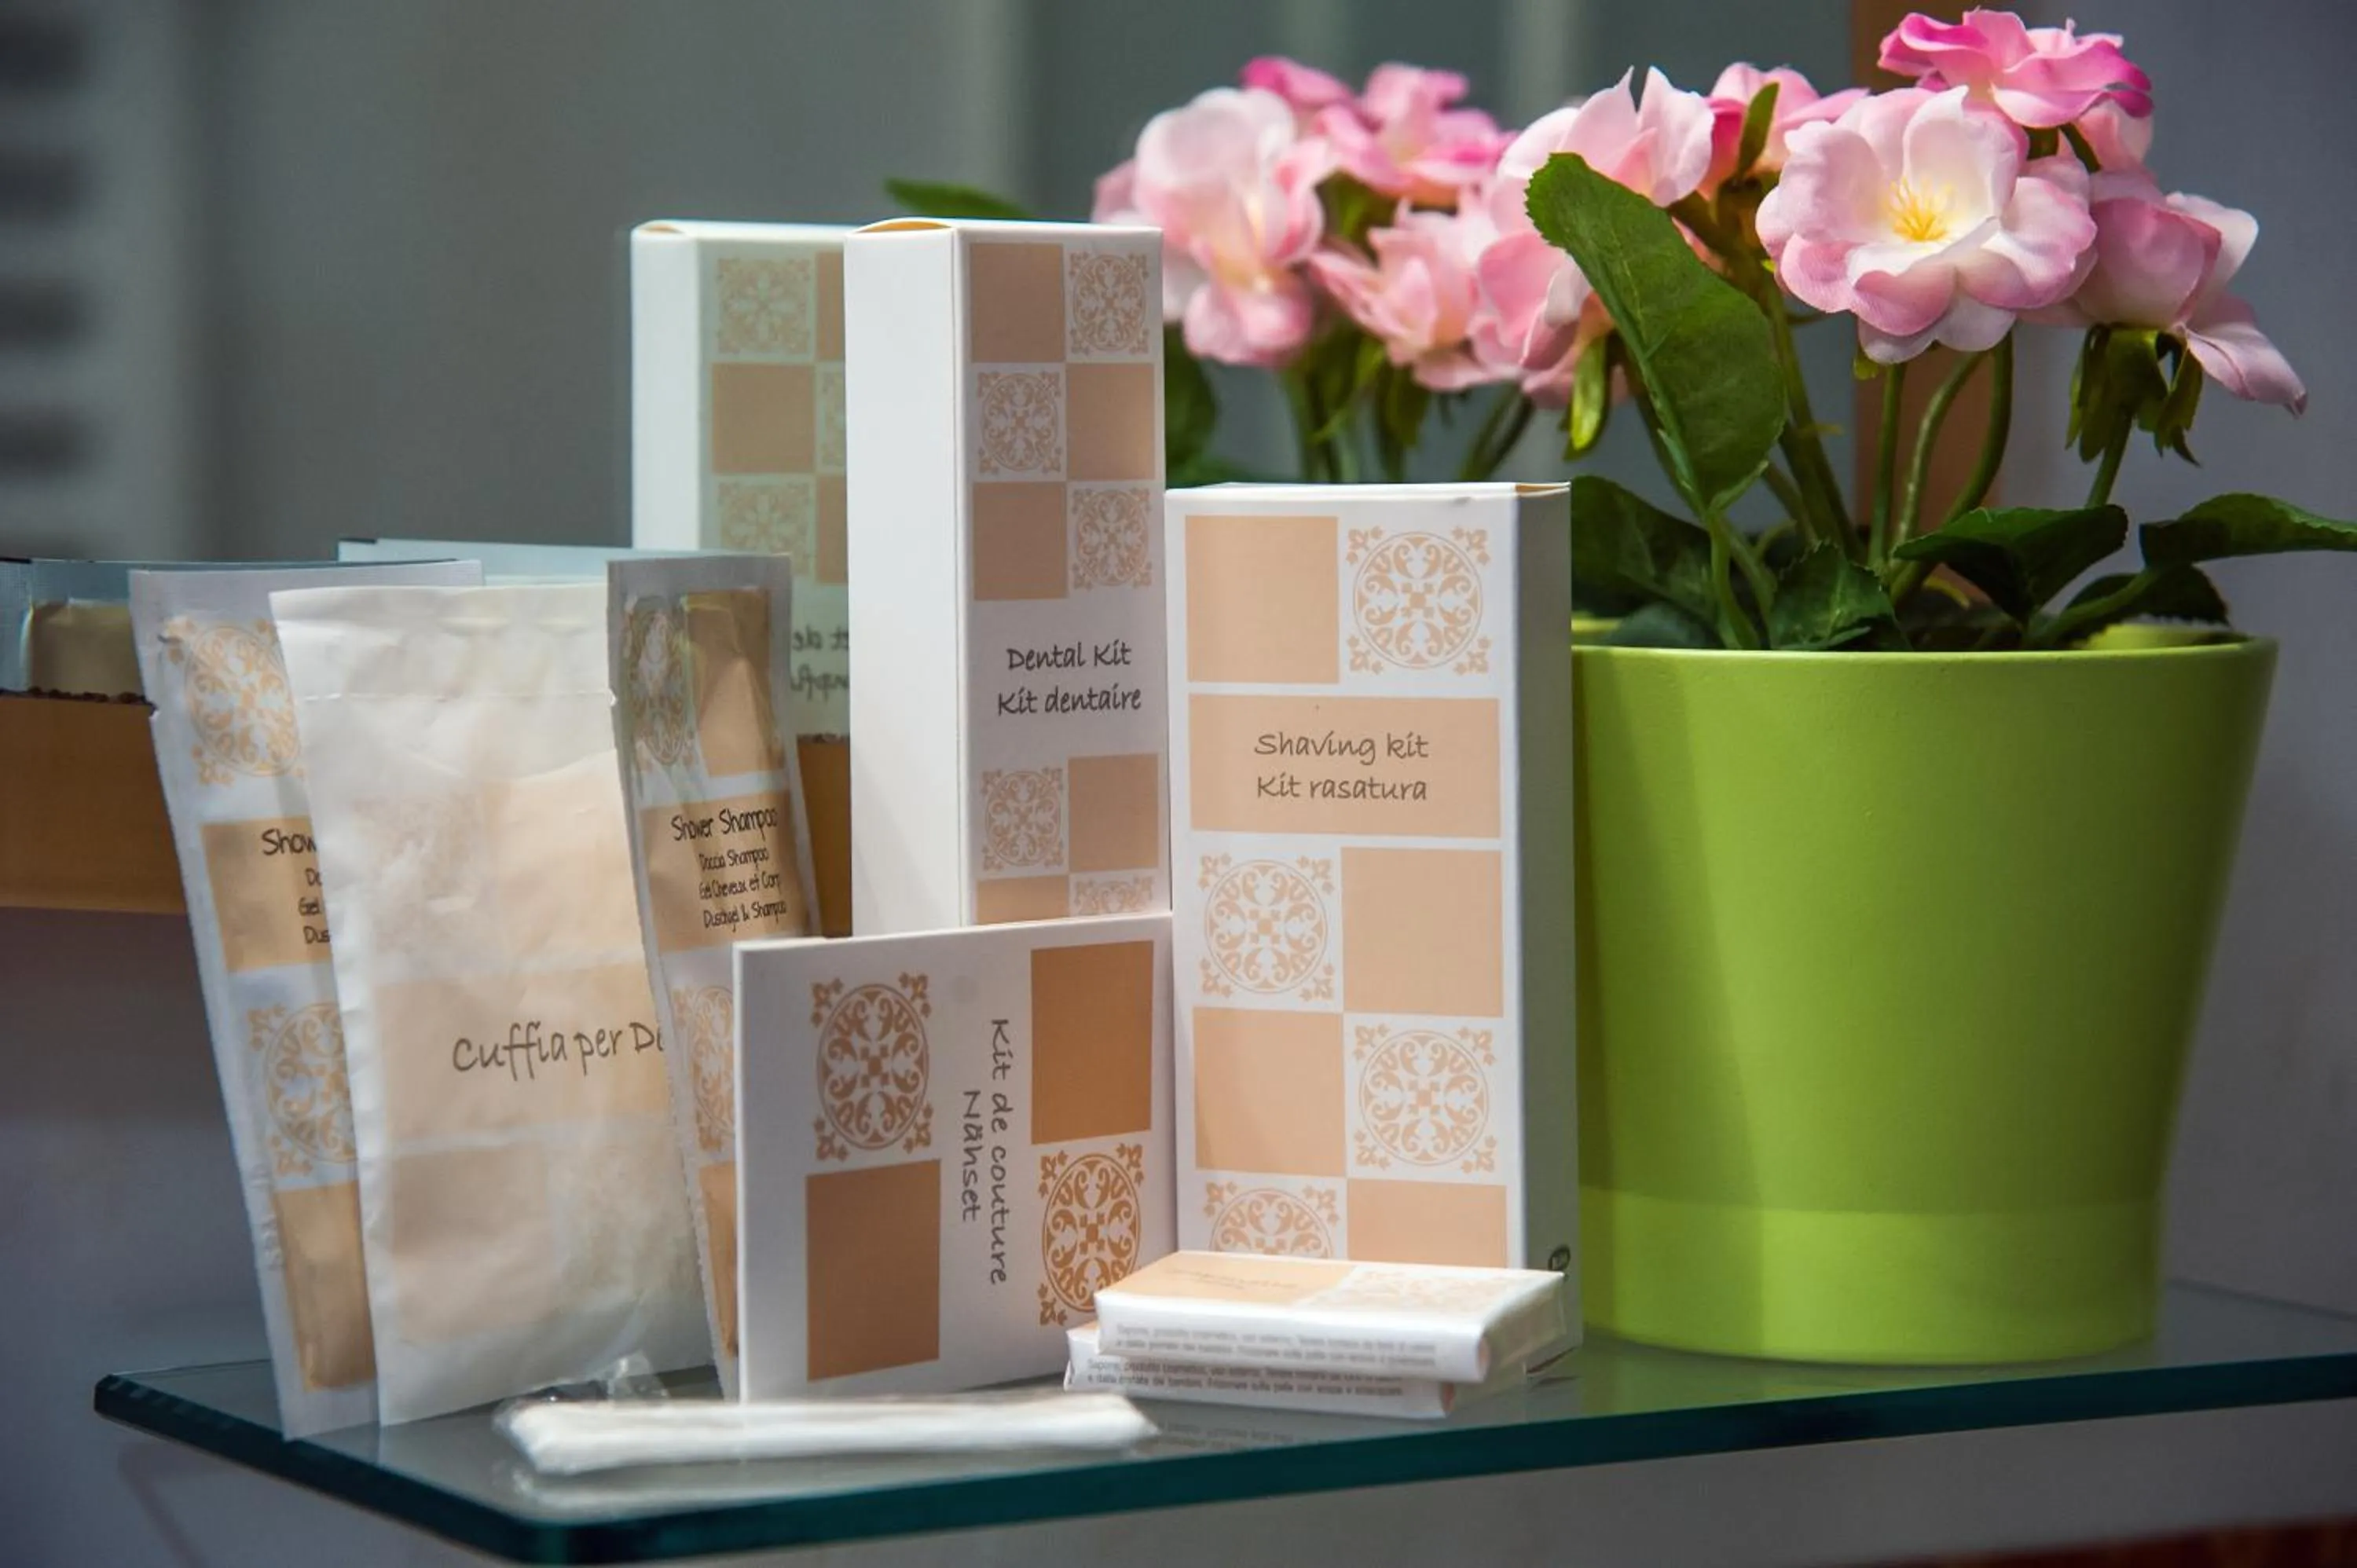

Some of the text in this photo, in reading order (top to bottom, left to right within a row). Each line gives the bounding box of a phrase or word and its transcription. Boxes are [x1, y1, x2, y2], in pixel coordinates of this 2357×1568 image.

[1006, 639, 1131, 671] Dental Kit
[998, 683, 1142, 716] Kit dentaire
[1254, 730, 1429, 765] Shaving kit
[1257, 771, 1427, 800] Kit rasatura
[671, 808, 778, 841] Shower Shampoo
[727, 847, 769, 870] Shampoo
[749, 873, 760, 891] et
[453, 1020, 567, 1082] Cuffia
[573, 1028, 622, 1076] per
[961, 1090, 984, 1222] Nähset
[990, 1019, 1014, 1285] Kit de couture
